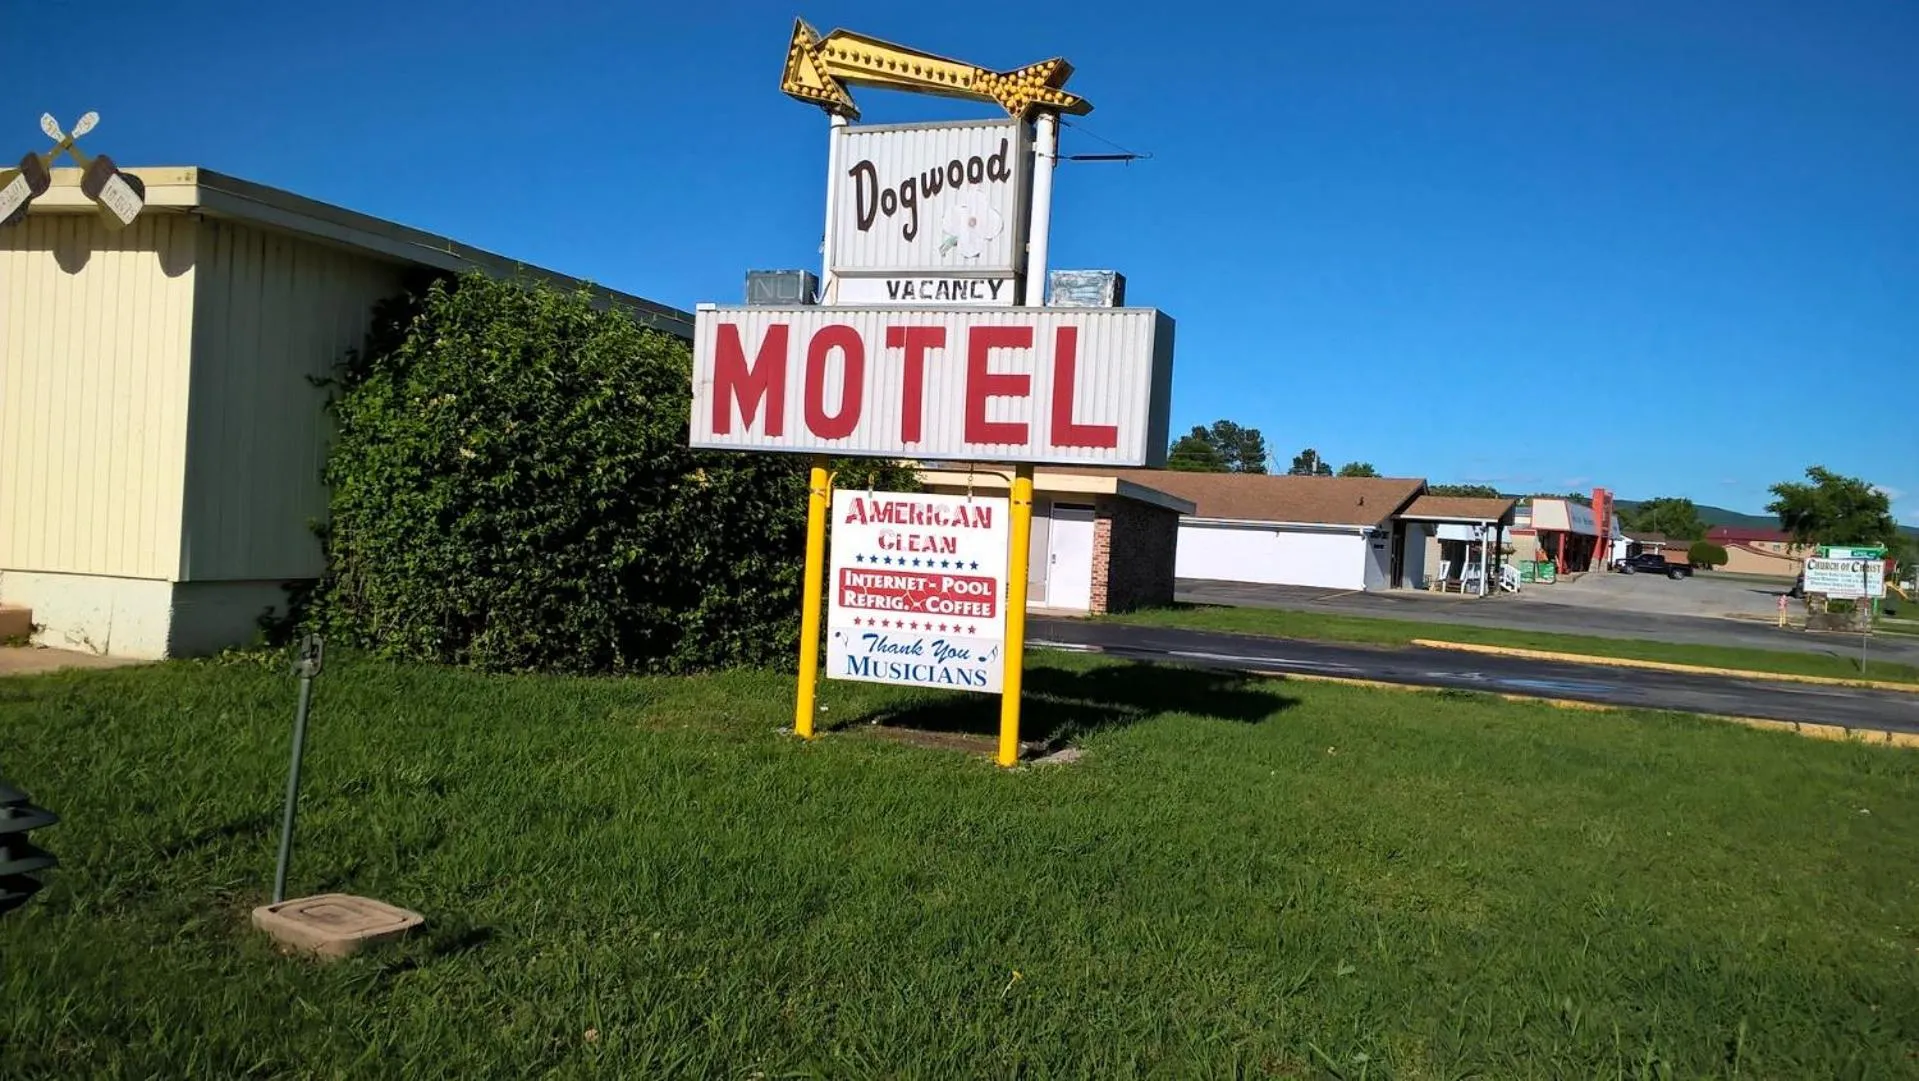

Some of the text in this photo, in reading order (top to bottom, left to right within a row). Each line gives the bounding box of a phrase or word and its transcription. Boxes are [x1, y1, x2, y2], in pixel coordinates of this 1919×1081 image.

[849, 138, 1011, 242] Dogwood
[886, 279, 1004, 301] VACANCY
[711, 323, 1118, 449] MOTEL
[845, 497, 993, 529] AMERICAN
[877, 528, 957, 554] CLEAN
[844, 570, 926, 591] INTERNET
[941, 578, 992, 596] POOL
[844, 590, 909, 611] REFRIG.
[925, 596, 991, 616] COFFEE
[862, 633, 971, 664] Thank You
[846, 654, 988, 686] MUSICIANS
